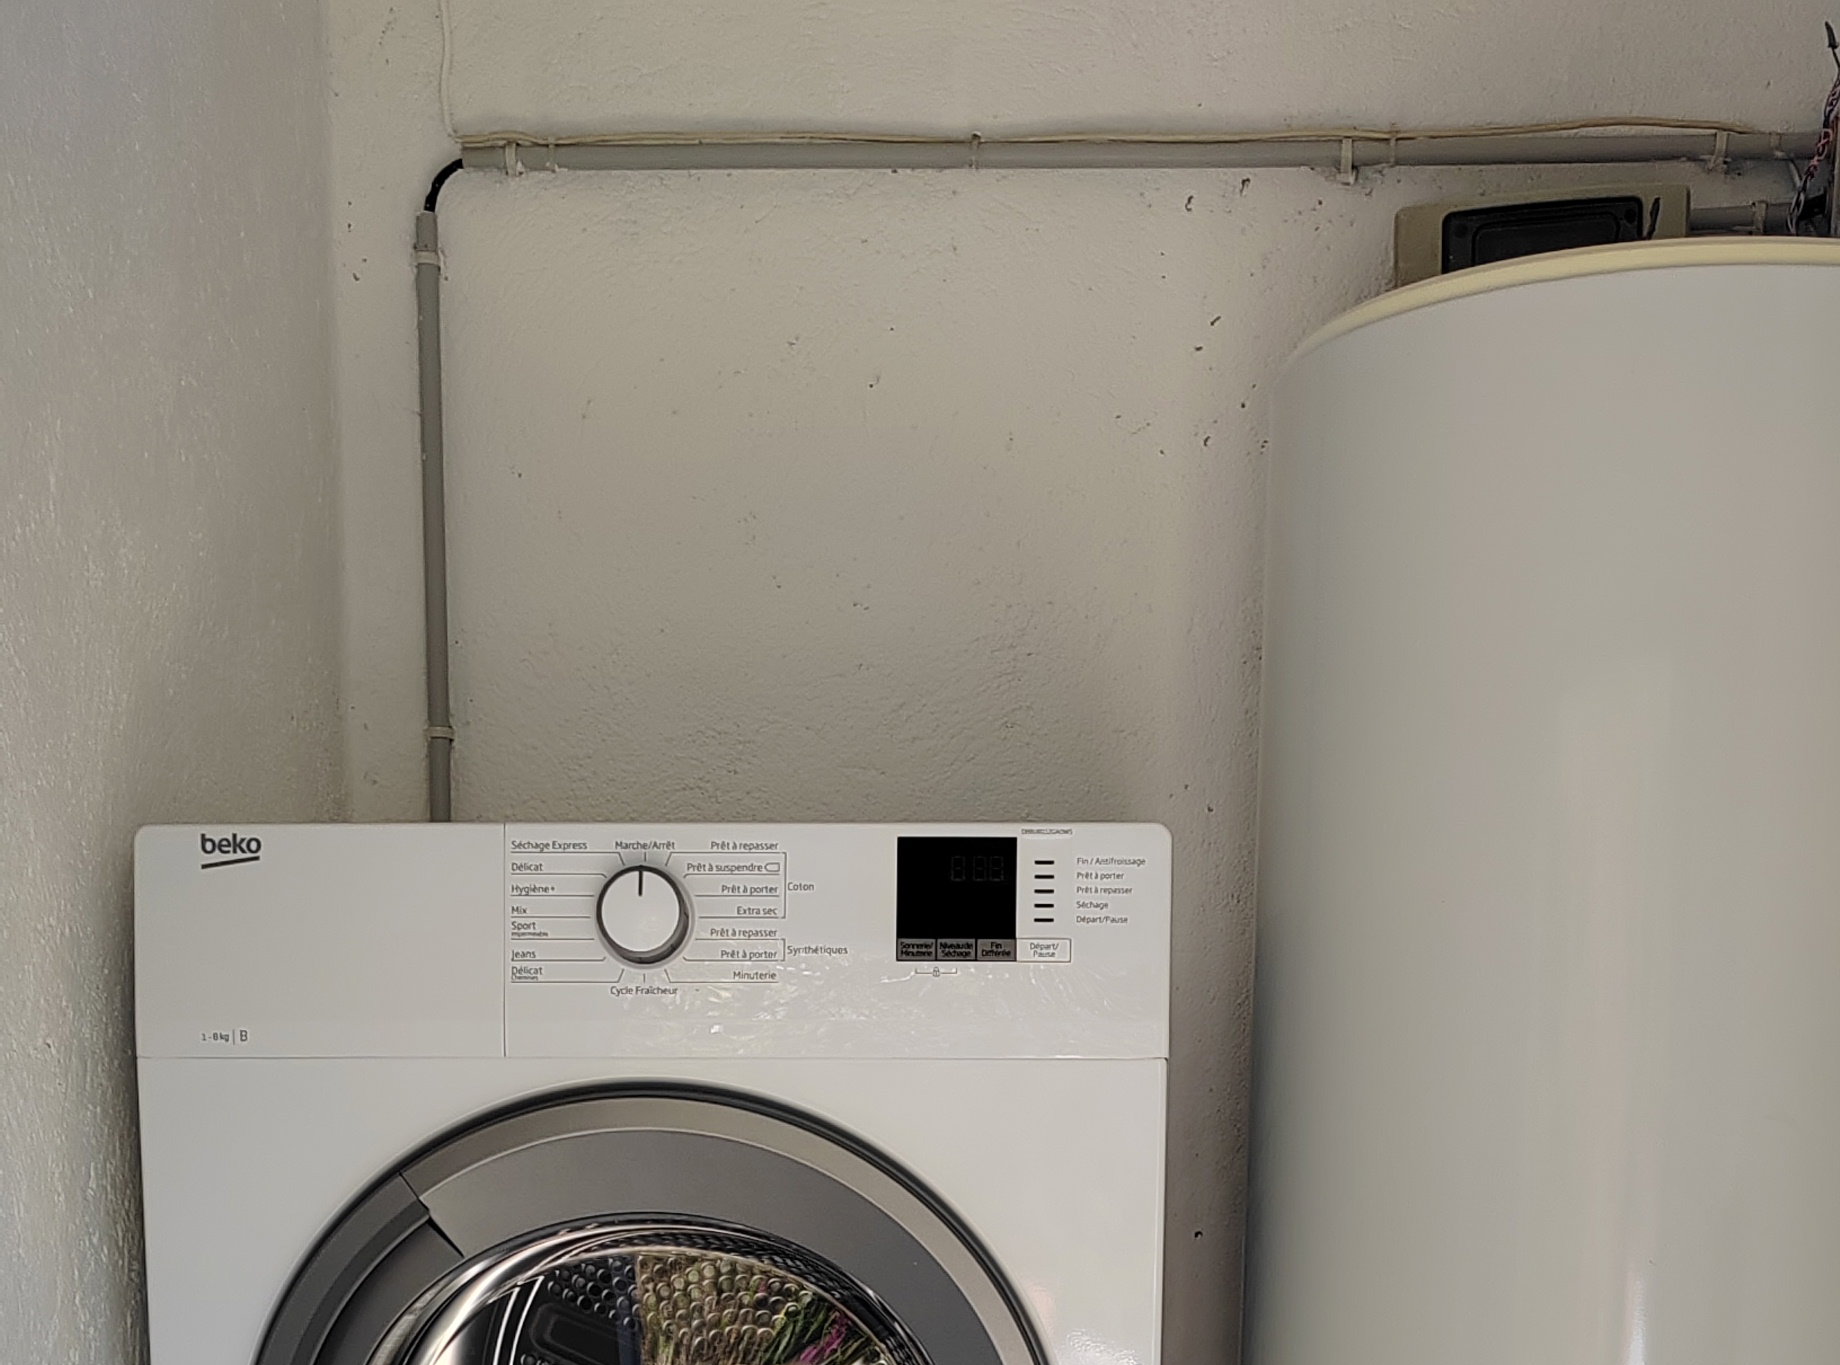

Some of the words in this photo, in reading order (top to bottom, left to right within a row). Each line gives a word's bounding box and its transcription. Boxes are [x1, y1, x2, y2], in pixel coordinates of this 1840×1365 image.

[201, 833, 261, 854] beko
[512, 841, 550, 852] Séchage
[552, 842, 587, 851] Express
[615, 841, 675, 850] Marche/Arrêt
[711, 841, 730, 850] Prêt
[732, 842, 737, 850] à
[739, 843, 778, 852] repasser
[512, 862, 543, 871] Délicat
[1076, 857, 1088, 865] Fin
[1095, 857, 1146, 866] Antifroissage
[687, 863, 706, 872] Prêt
[708, 863, 713, 872] à
[715, 864, 763, 873] suspendre
[1076, 871, 1092, 880] Prêt
[1093, 872, 1099, 880] à
[1100, 872, 1124, 882] porter
[722, 885, 741, 893] Prêt
[743, 885, 748, 893] à
[750, 886, 778, 895] porter
[788, 882, 814, 891] Coton
[1076, 886, 1092, 894] Prêt
[1093, 886, 1099, 894] à
[1100, 886, 1132, 896] repasser
[512, 906, 527, 914] Mix
[1076, 900, 1108, 910] Séchage
[737, 907, 761, 915] Extra
[1076, 914, 1128, 925] Départ/Pause
[512, 922, 536, 931] Sport
[710, 928, 730, 936] Prêt
[732, 928, 737, 936] à
[738, 930, 777, 938] repasser
[721, 950, 740, 958] Prêt
[742, 950, 747, 958] à
[749, 951, 778, 960] porter
[787, 945, 848, 955] Synthétiques
[1033, 950, 1056, 958] Pause
[512, 950, 536, 961] Jeans
[512, 966, 542, 975] Délicat
[733, 970, 777, 980] Minuterie
[610, 986, 633, 996] Cycle
[636, 986, 678, 995] Fraîcheur
